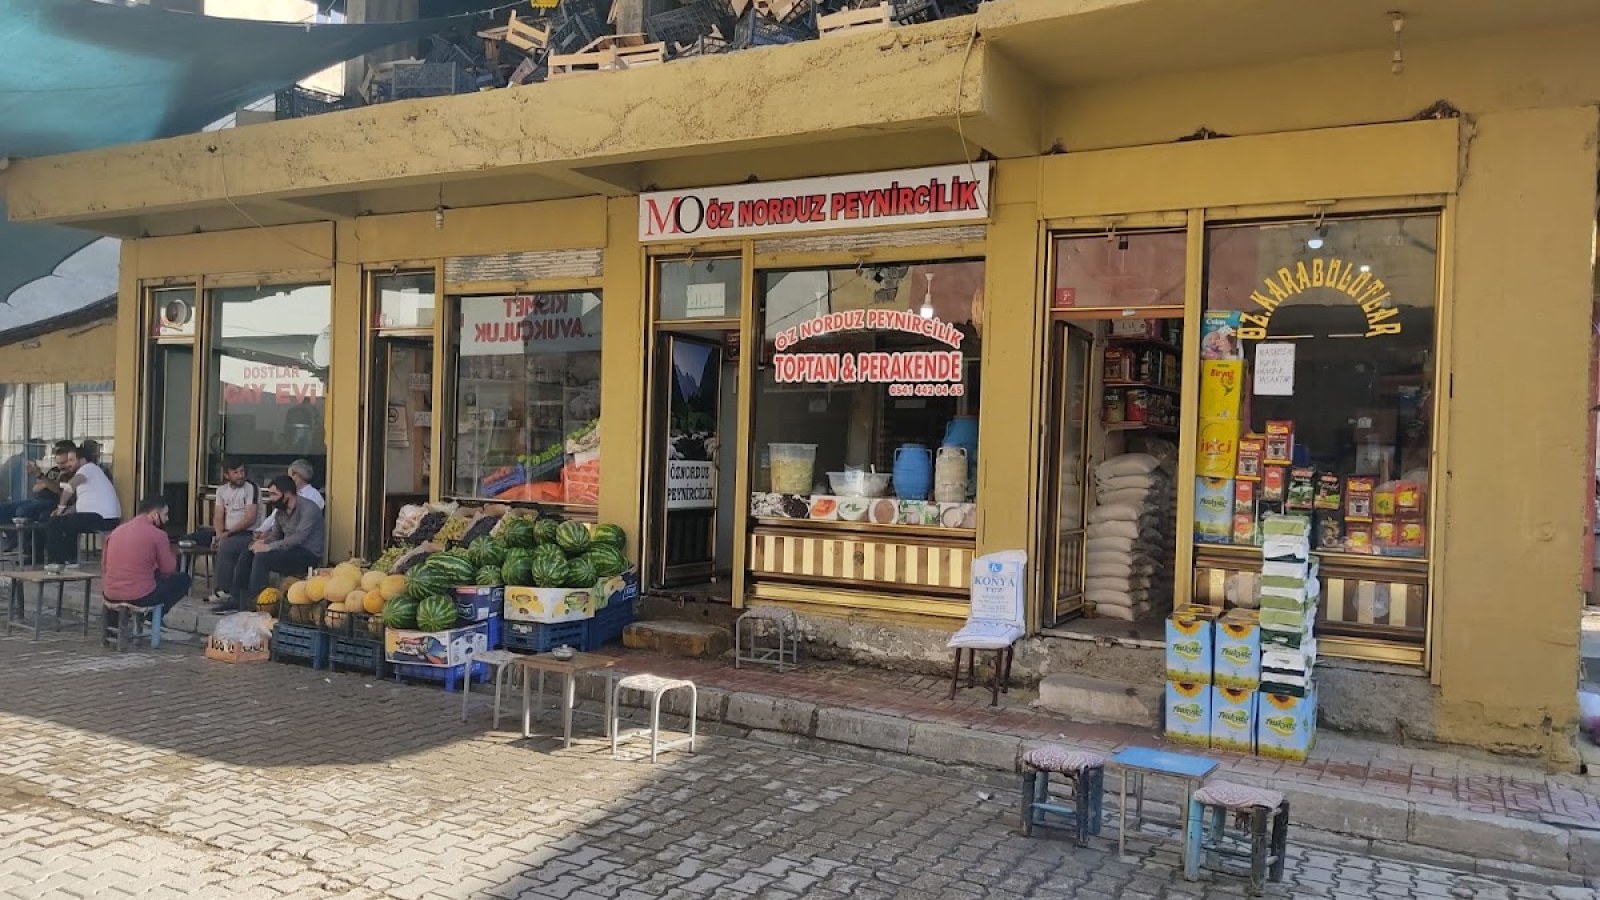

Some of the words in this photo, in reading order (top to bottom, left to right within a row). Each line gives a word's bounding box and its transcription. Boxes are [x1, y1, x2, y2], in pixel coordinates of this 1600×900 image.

[706, 198, 734, 229] ÖZ
[738, 195, 826, 227] NORDUZ
[831, 176, 980, 220] PEYNİRCİLİK
[775, 327, 799, 351] ÖZ
[800, 309, 865, 340] NORDUZ
[867, 309, 965, 349] PEYNİRCİLİK
[243, 366, 300, 379] DOSTLAR
[774, 353, 840, 383] TOPTAN
[841, 353, 857, 382] &
[857, 351, 963, 382] PERAKENDE
[889, 384, 914, 396] 0541
[915, 384, 935, 396] 442
[935, 384, 949, 396] 04
[974, 576, 1015, 587] KONYA
